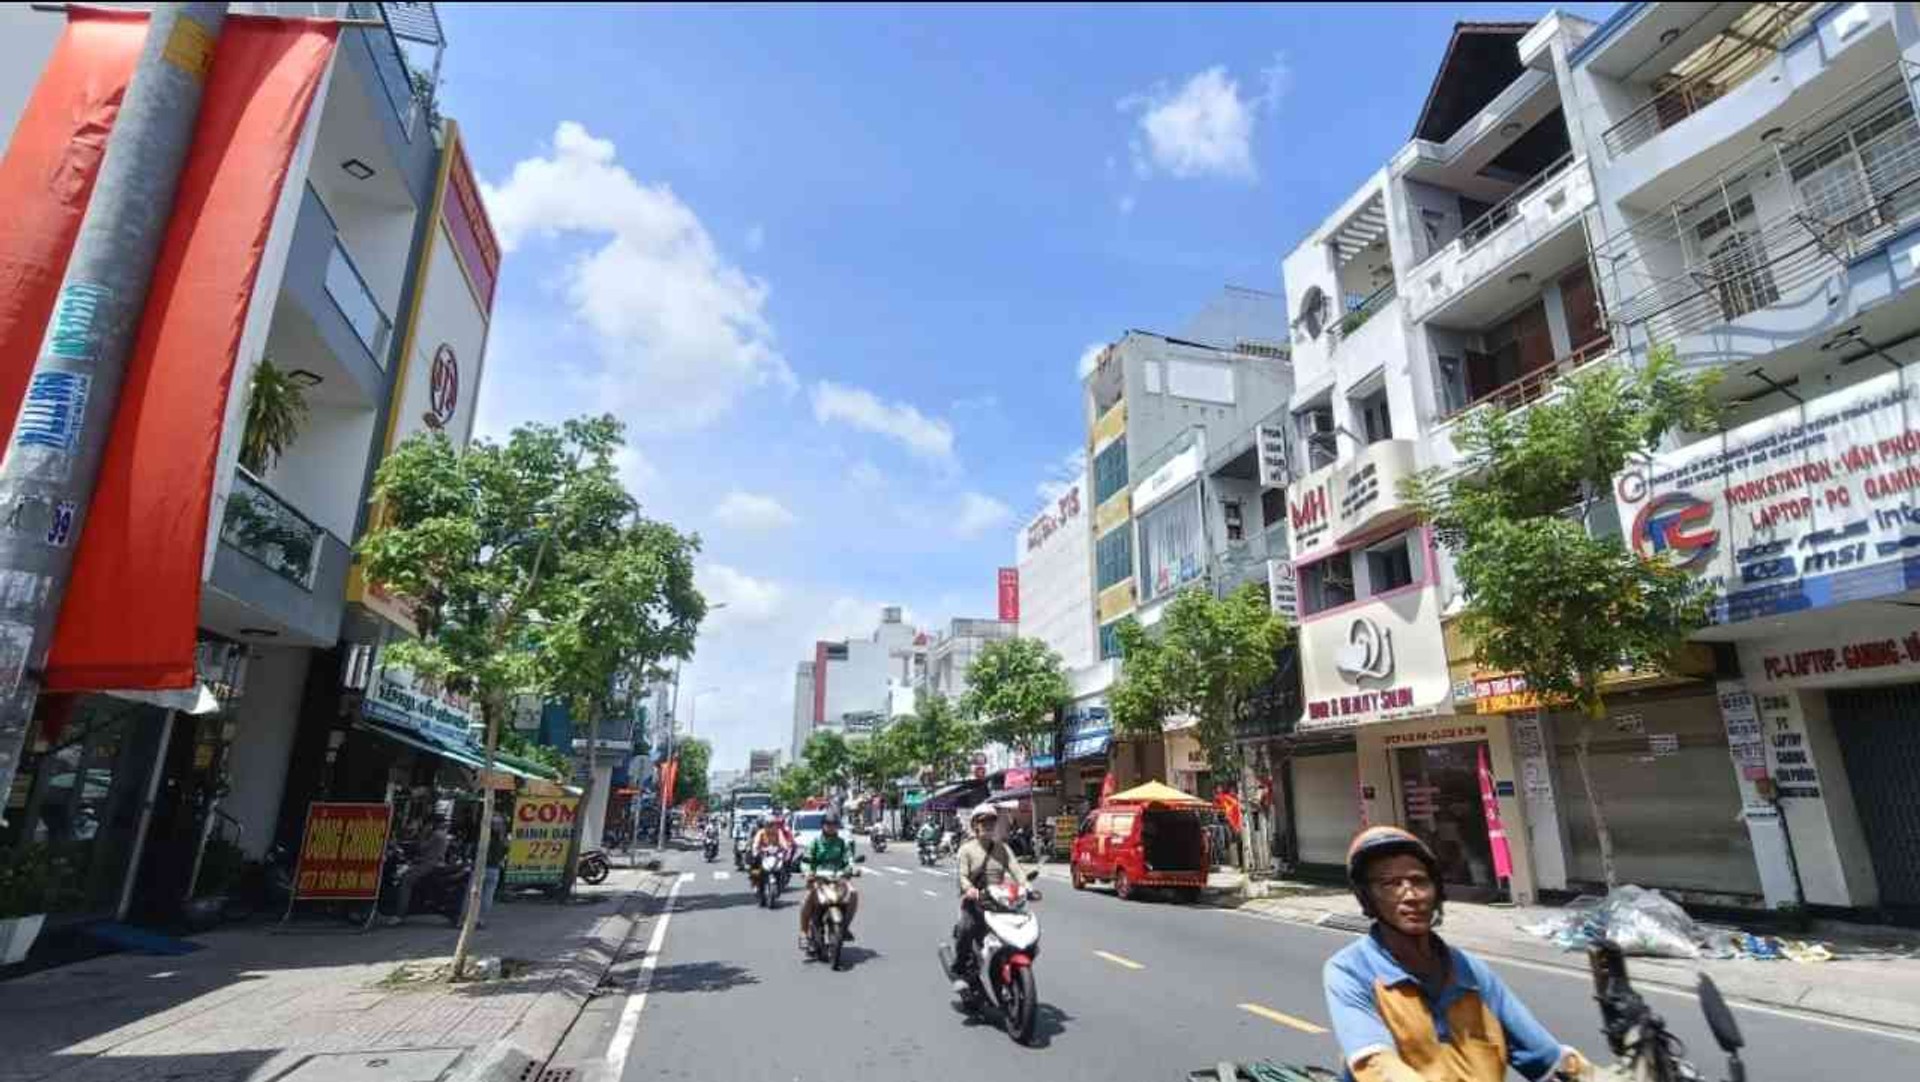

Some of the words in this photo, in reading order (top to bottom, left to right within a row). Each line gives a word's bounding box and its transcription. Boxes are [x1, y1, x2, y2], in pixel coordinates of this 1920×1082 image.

[1724, 459, 1833, 505] WORKSTATION
[1750, 496, 1813, 531] LAPTOP
[1825, 486, 1851, 511] PC
